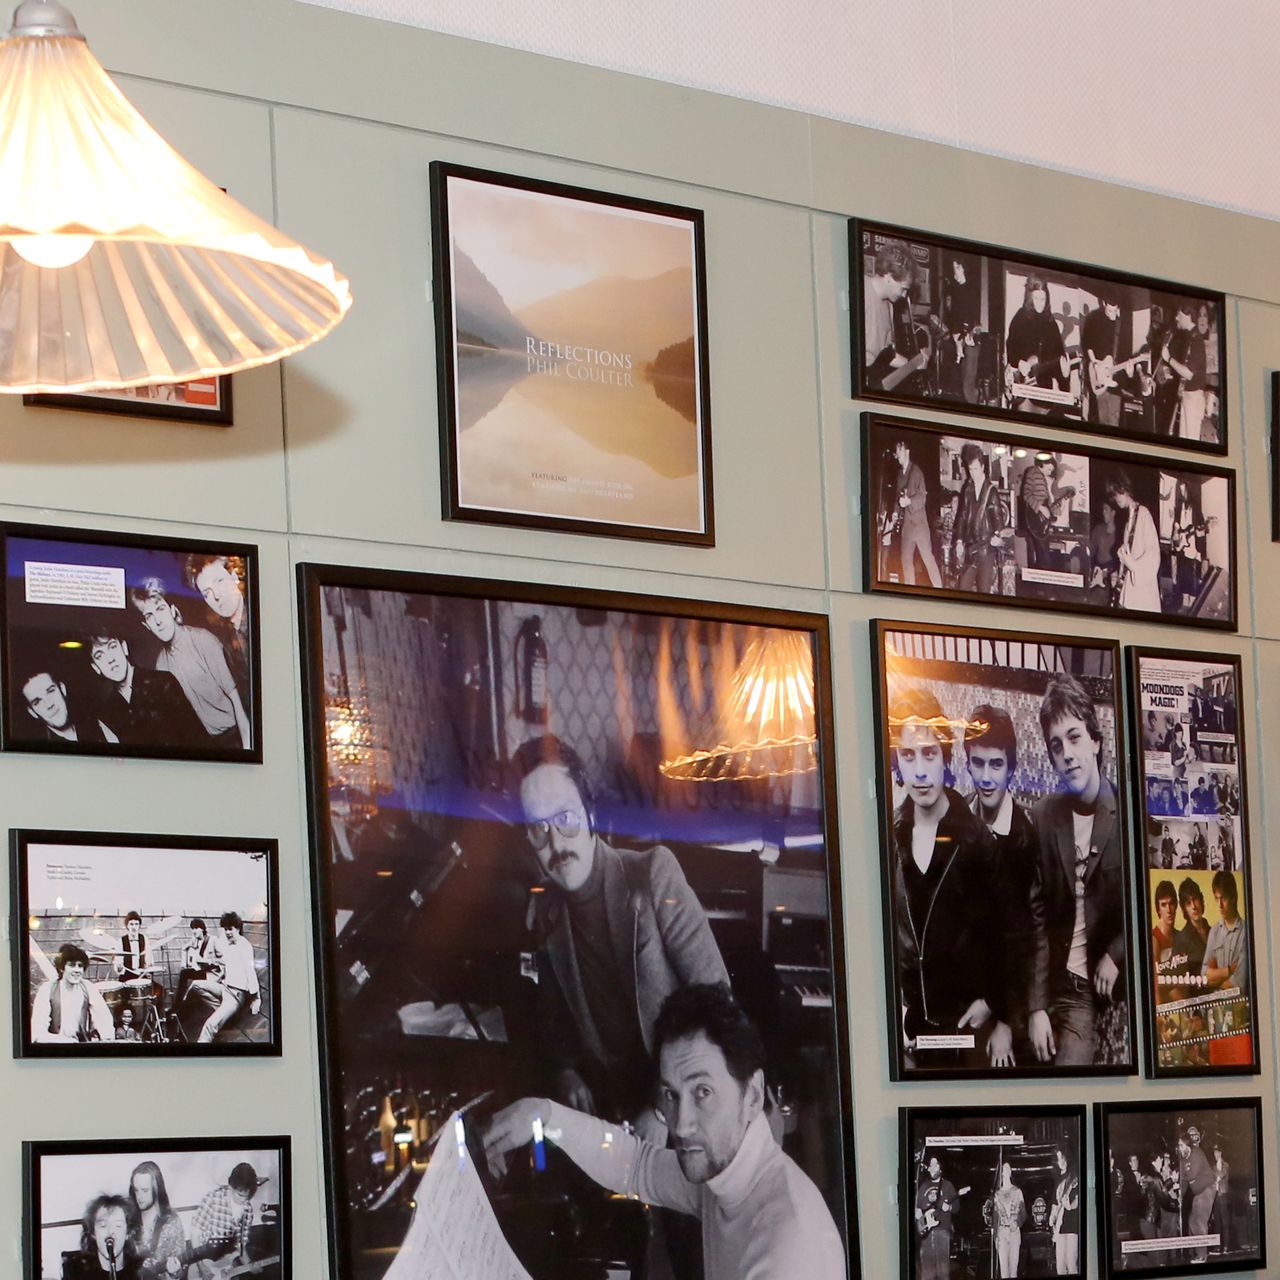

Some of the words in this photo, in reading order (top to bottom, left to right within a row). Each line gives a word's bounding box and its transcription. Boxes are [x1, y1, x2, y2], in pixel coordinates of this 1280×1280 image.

[526, 336, 632, 369] REFLECTIONS
[527, 356, 561, 376] PHIL
[566, 362, 634, 387] COULTER
[1141, 683, 1184, 697] MOONDOGS
[1211, 676, 1229, 698] TV
[1155, 961, 1170, 974] Love
[1171, 954, 1188, 970] Affair
[1157, 972, 1208, 988] moondogs
